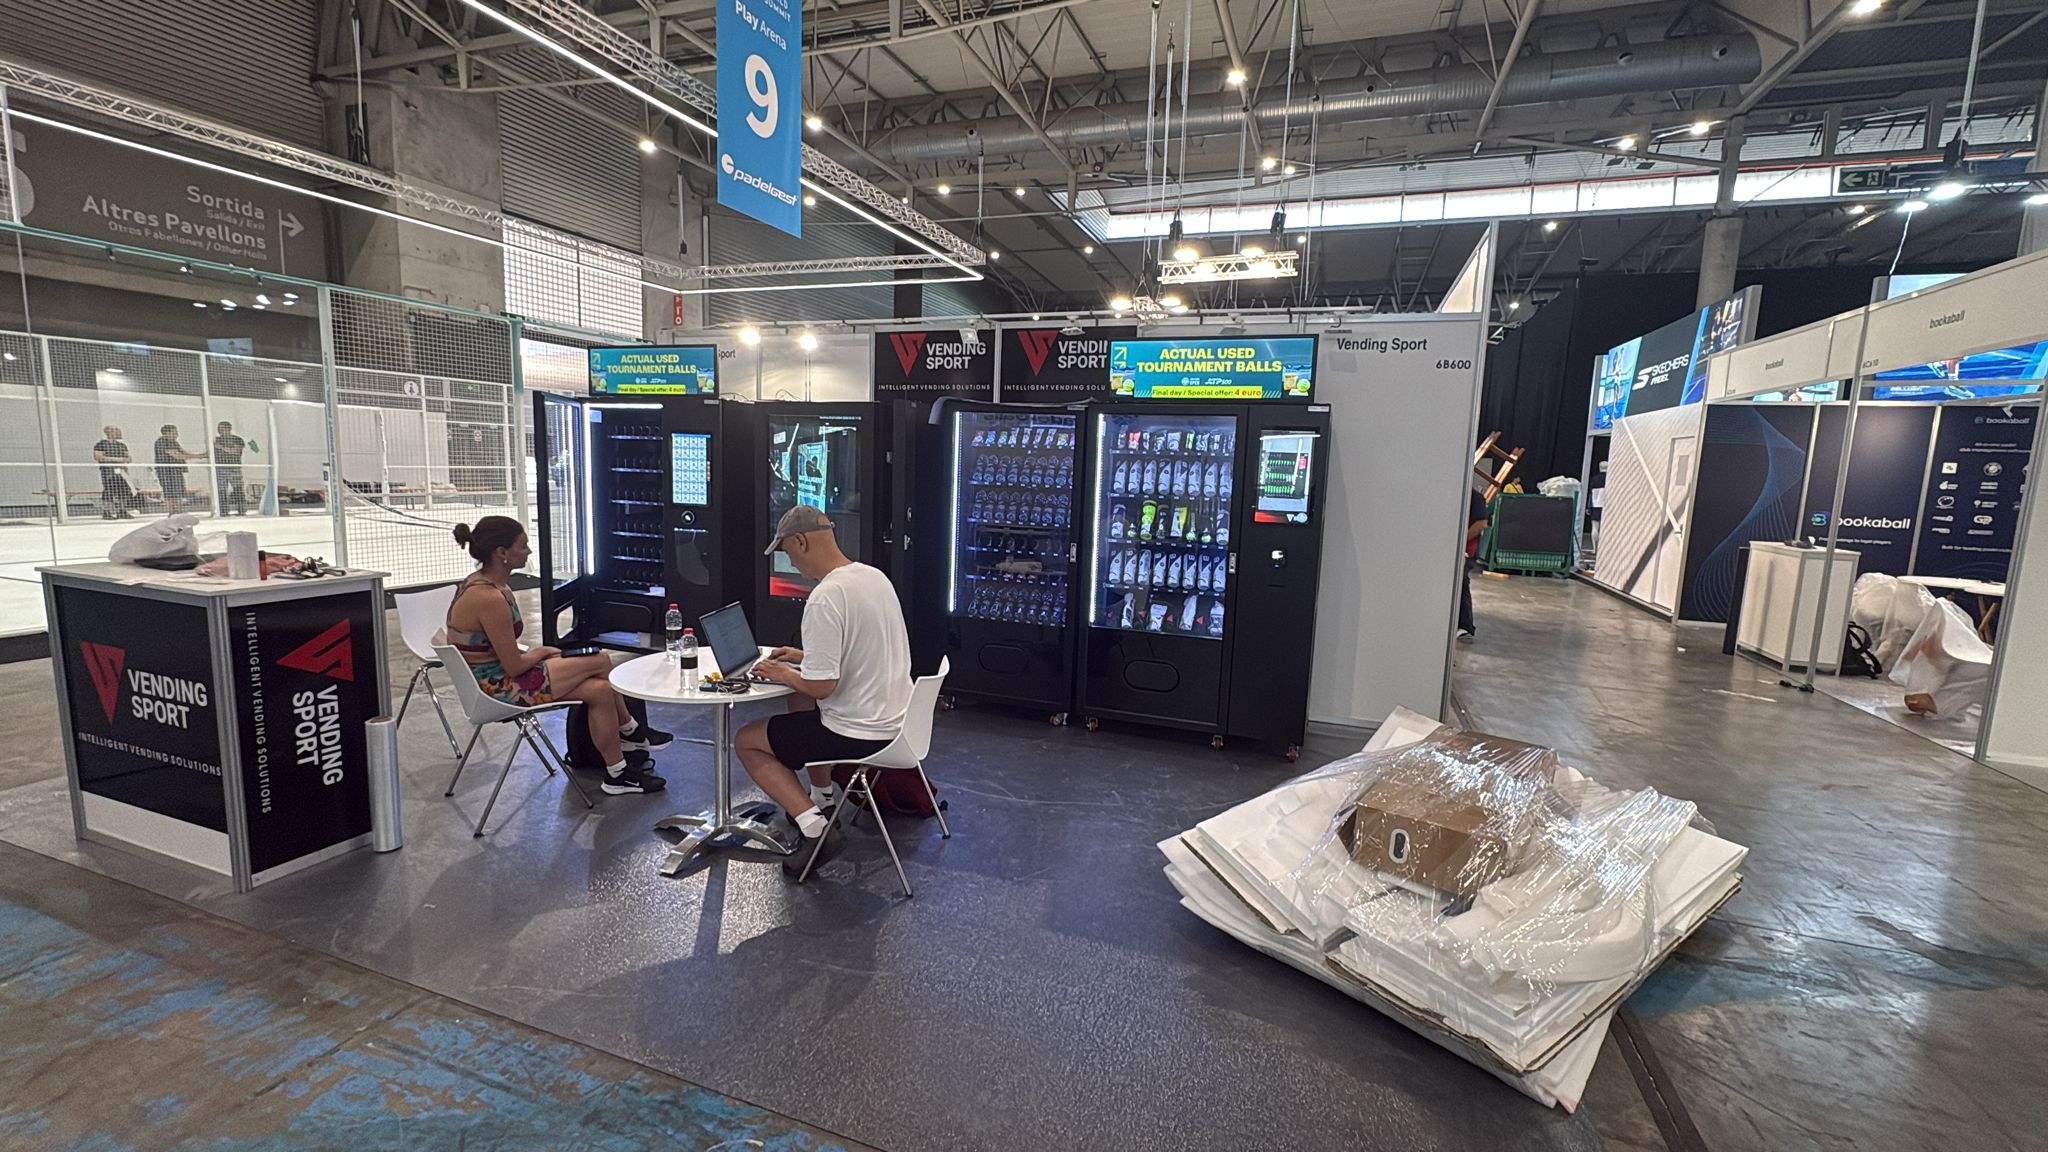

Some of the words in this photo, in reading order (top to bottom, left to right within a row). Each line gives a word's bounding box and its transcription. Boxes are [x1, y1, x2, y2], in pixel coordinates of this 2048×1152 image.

[735, 0, 759, 31] Play
[760, 20, 787, 51] Arena
[745, 54, 779, 139] 9
[186, 185, 265, 220] Sortida
[82, 194, 160, 227] Altres
[165, 211, 267, 250] Pavellons
[206, 209, 238, 225] Salida
[107, 221, 143, 237] Otros
[213, 242, 242, 256] Other
[1929, 310, 1966, 329] bookaball
[620, 354, 655, 364] ACTUAL
[656, 354, 680, 364] USED
[926, 342, 987, 356] VENDING
[1159, 347, 1215, 360] ACTUAL
[1221, 346, 1256, 359] USED
[1336, 337, 1388, 354] Vending
[1391, 337, 1428, 353] Sport
[606, 364, 668, 374] TOURNAMENT
[668, 364, 697, 374] BALLS
[926, 356, 972, 370] SPORT
[1057, 355, 1108, 369] SPORT
[1136, 360, 1234, 373] TOURNAMENT
[1235, 360, 1283, 373] BALLS
[1435, 359, 1472, 370] 6B600
[1651, 354, 1690, 377] SKECHERS
[1169, 389, 1181, 397] day
[1187, 389, 1214, 397] Special
[1234, 388, 1240, 396] 4
[245, 611, 263, 688] INTELLIGENT
[127, 668, 208, 707] VENDING
[131, 695, 190, 729] SPORT
[252, 690, 267, 745] VENDING
[292, 690, 319, 766] SPORT
[316, 684, 344, 786] VENDING
[78, 732, 129, 753] INTELLIGENT
[129, 745, 169, 763] VENDING
[170, 754, 222, 777] SOLUTIONS
[256, 747, 272, 814] SOLUTIONS
